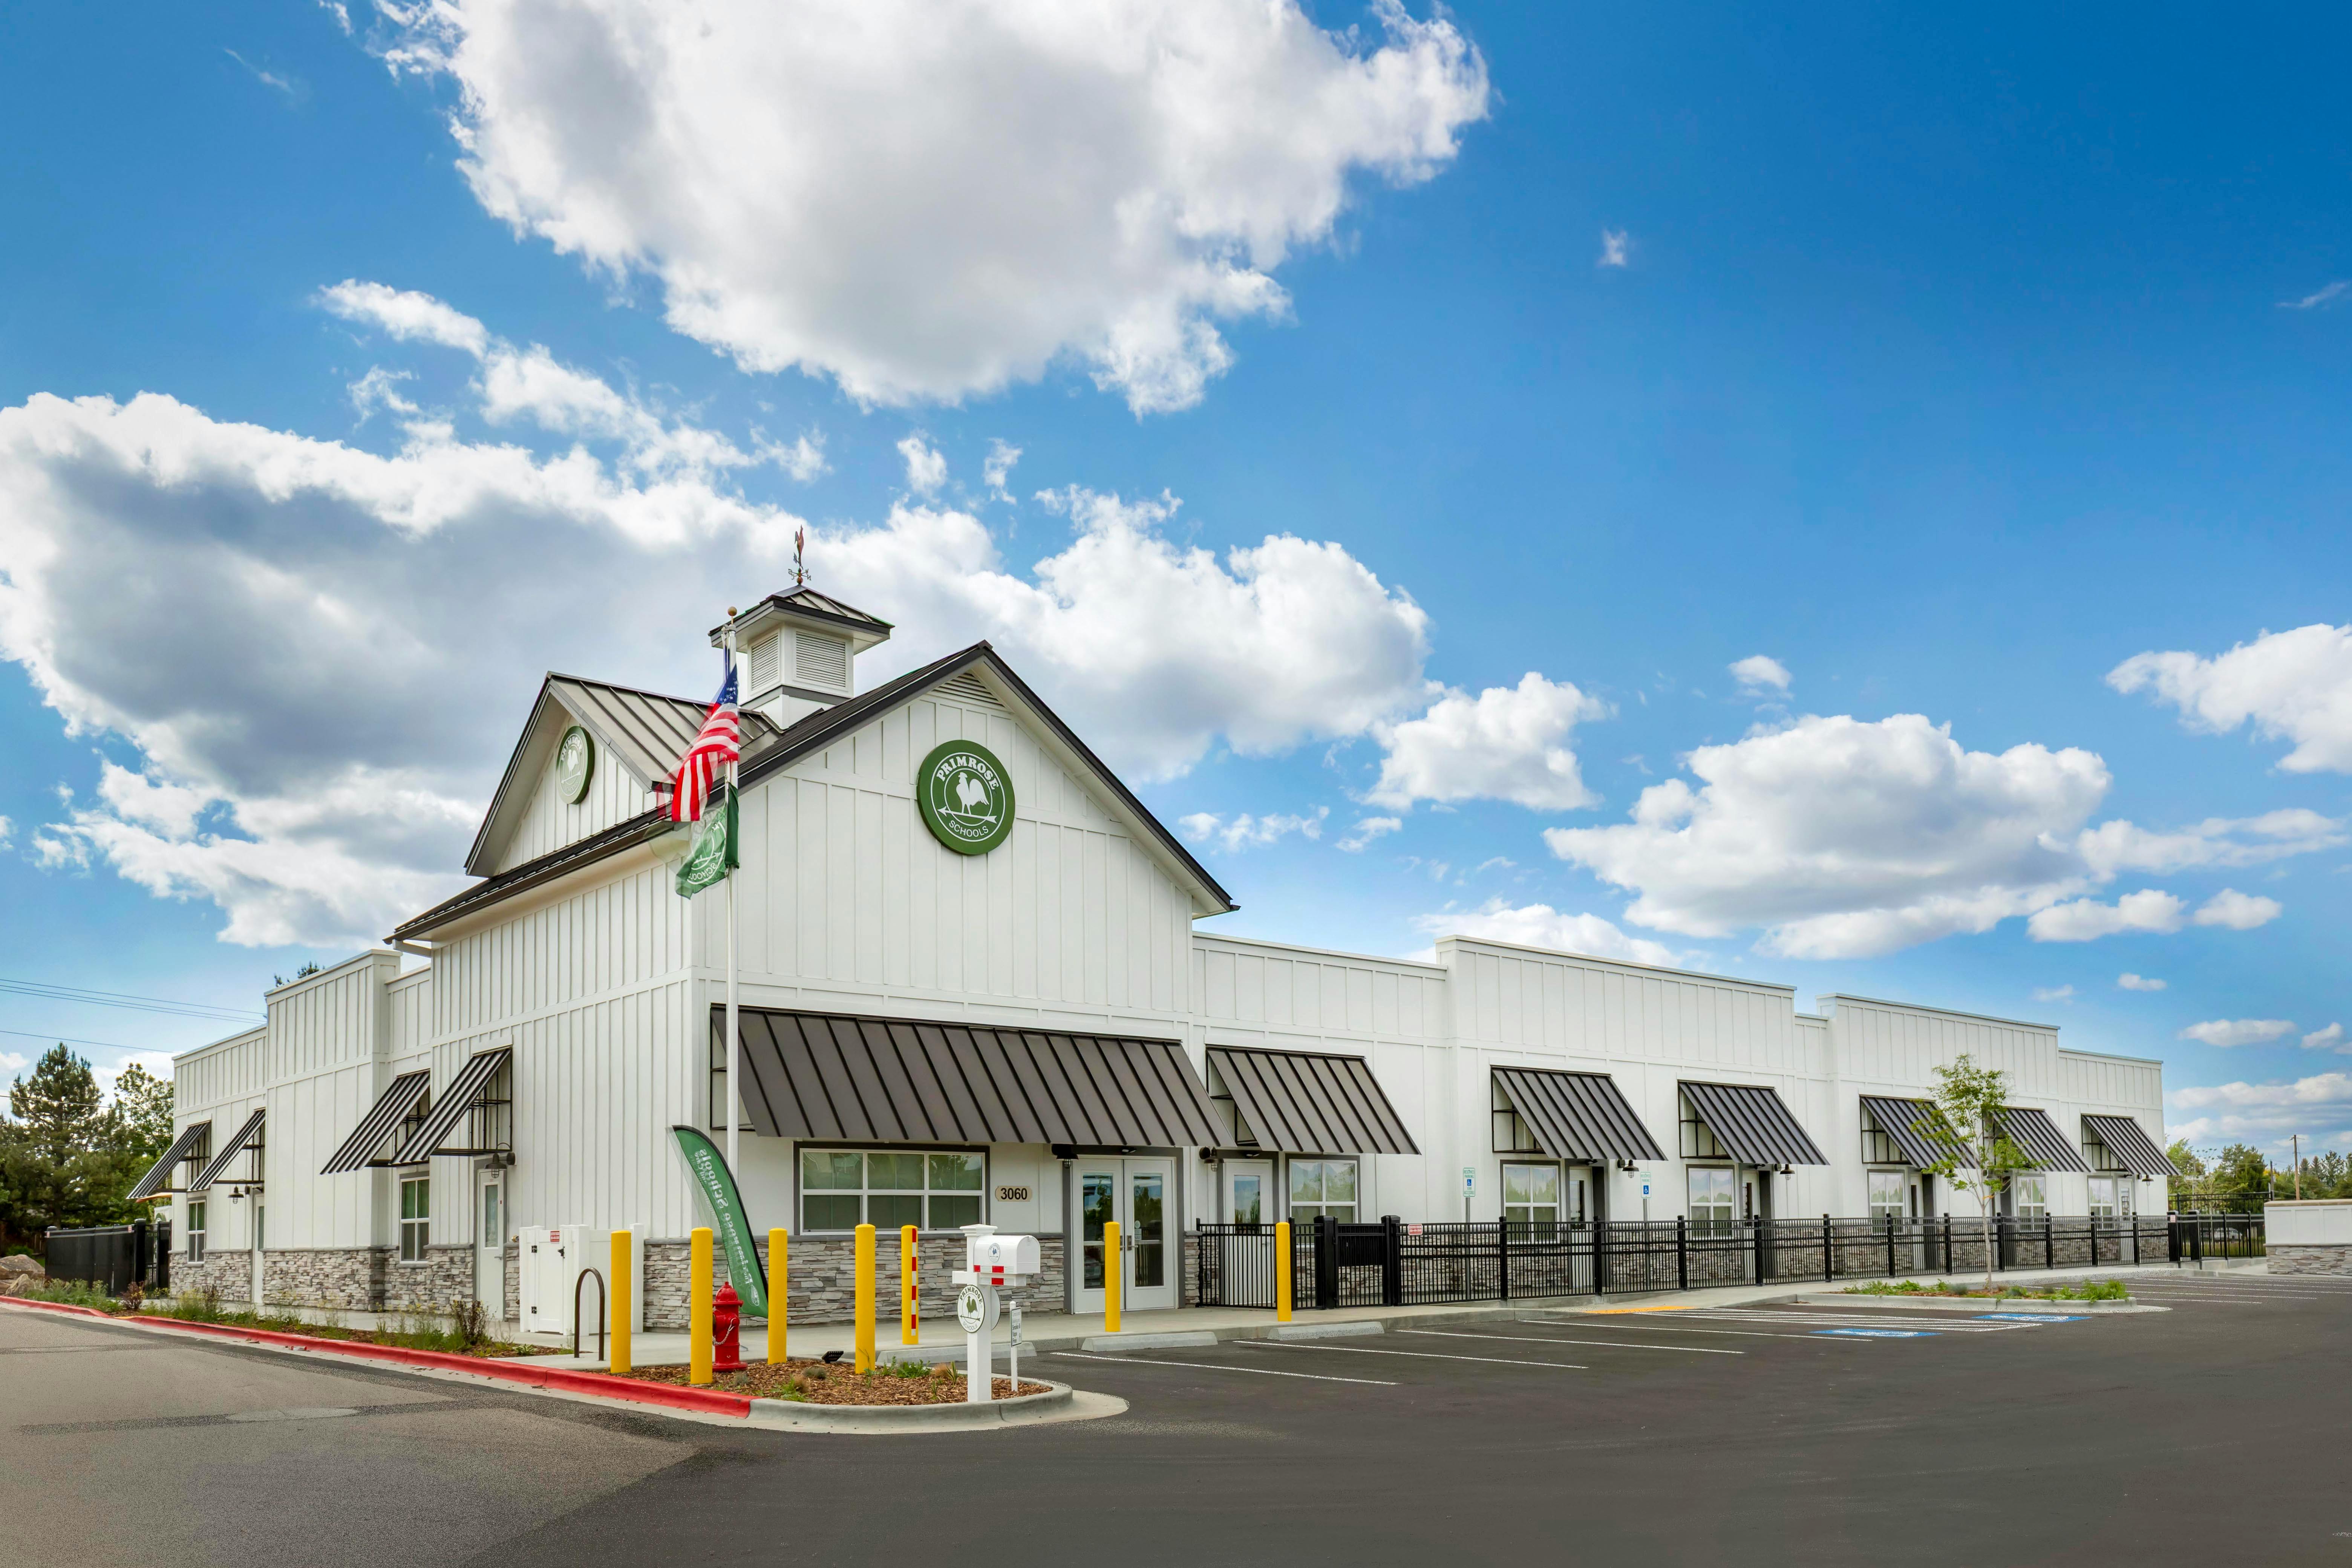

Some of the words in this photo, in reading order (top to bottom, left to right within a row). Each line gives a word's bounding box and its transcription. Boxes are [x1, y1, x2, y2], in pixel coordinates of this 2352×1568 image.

[561, 736, 582, 761] PRIMROSE
[936, 756, 999, 790] PRIMROSE
[949, 820, 989, 837] SCHOOLS
[1001, 1188, 1027, 1200] 3060
[960, 1286, 983, 1304] PRIMROSE
